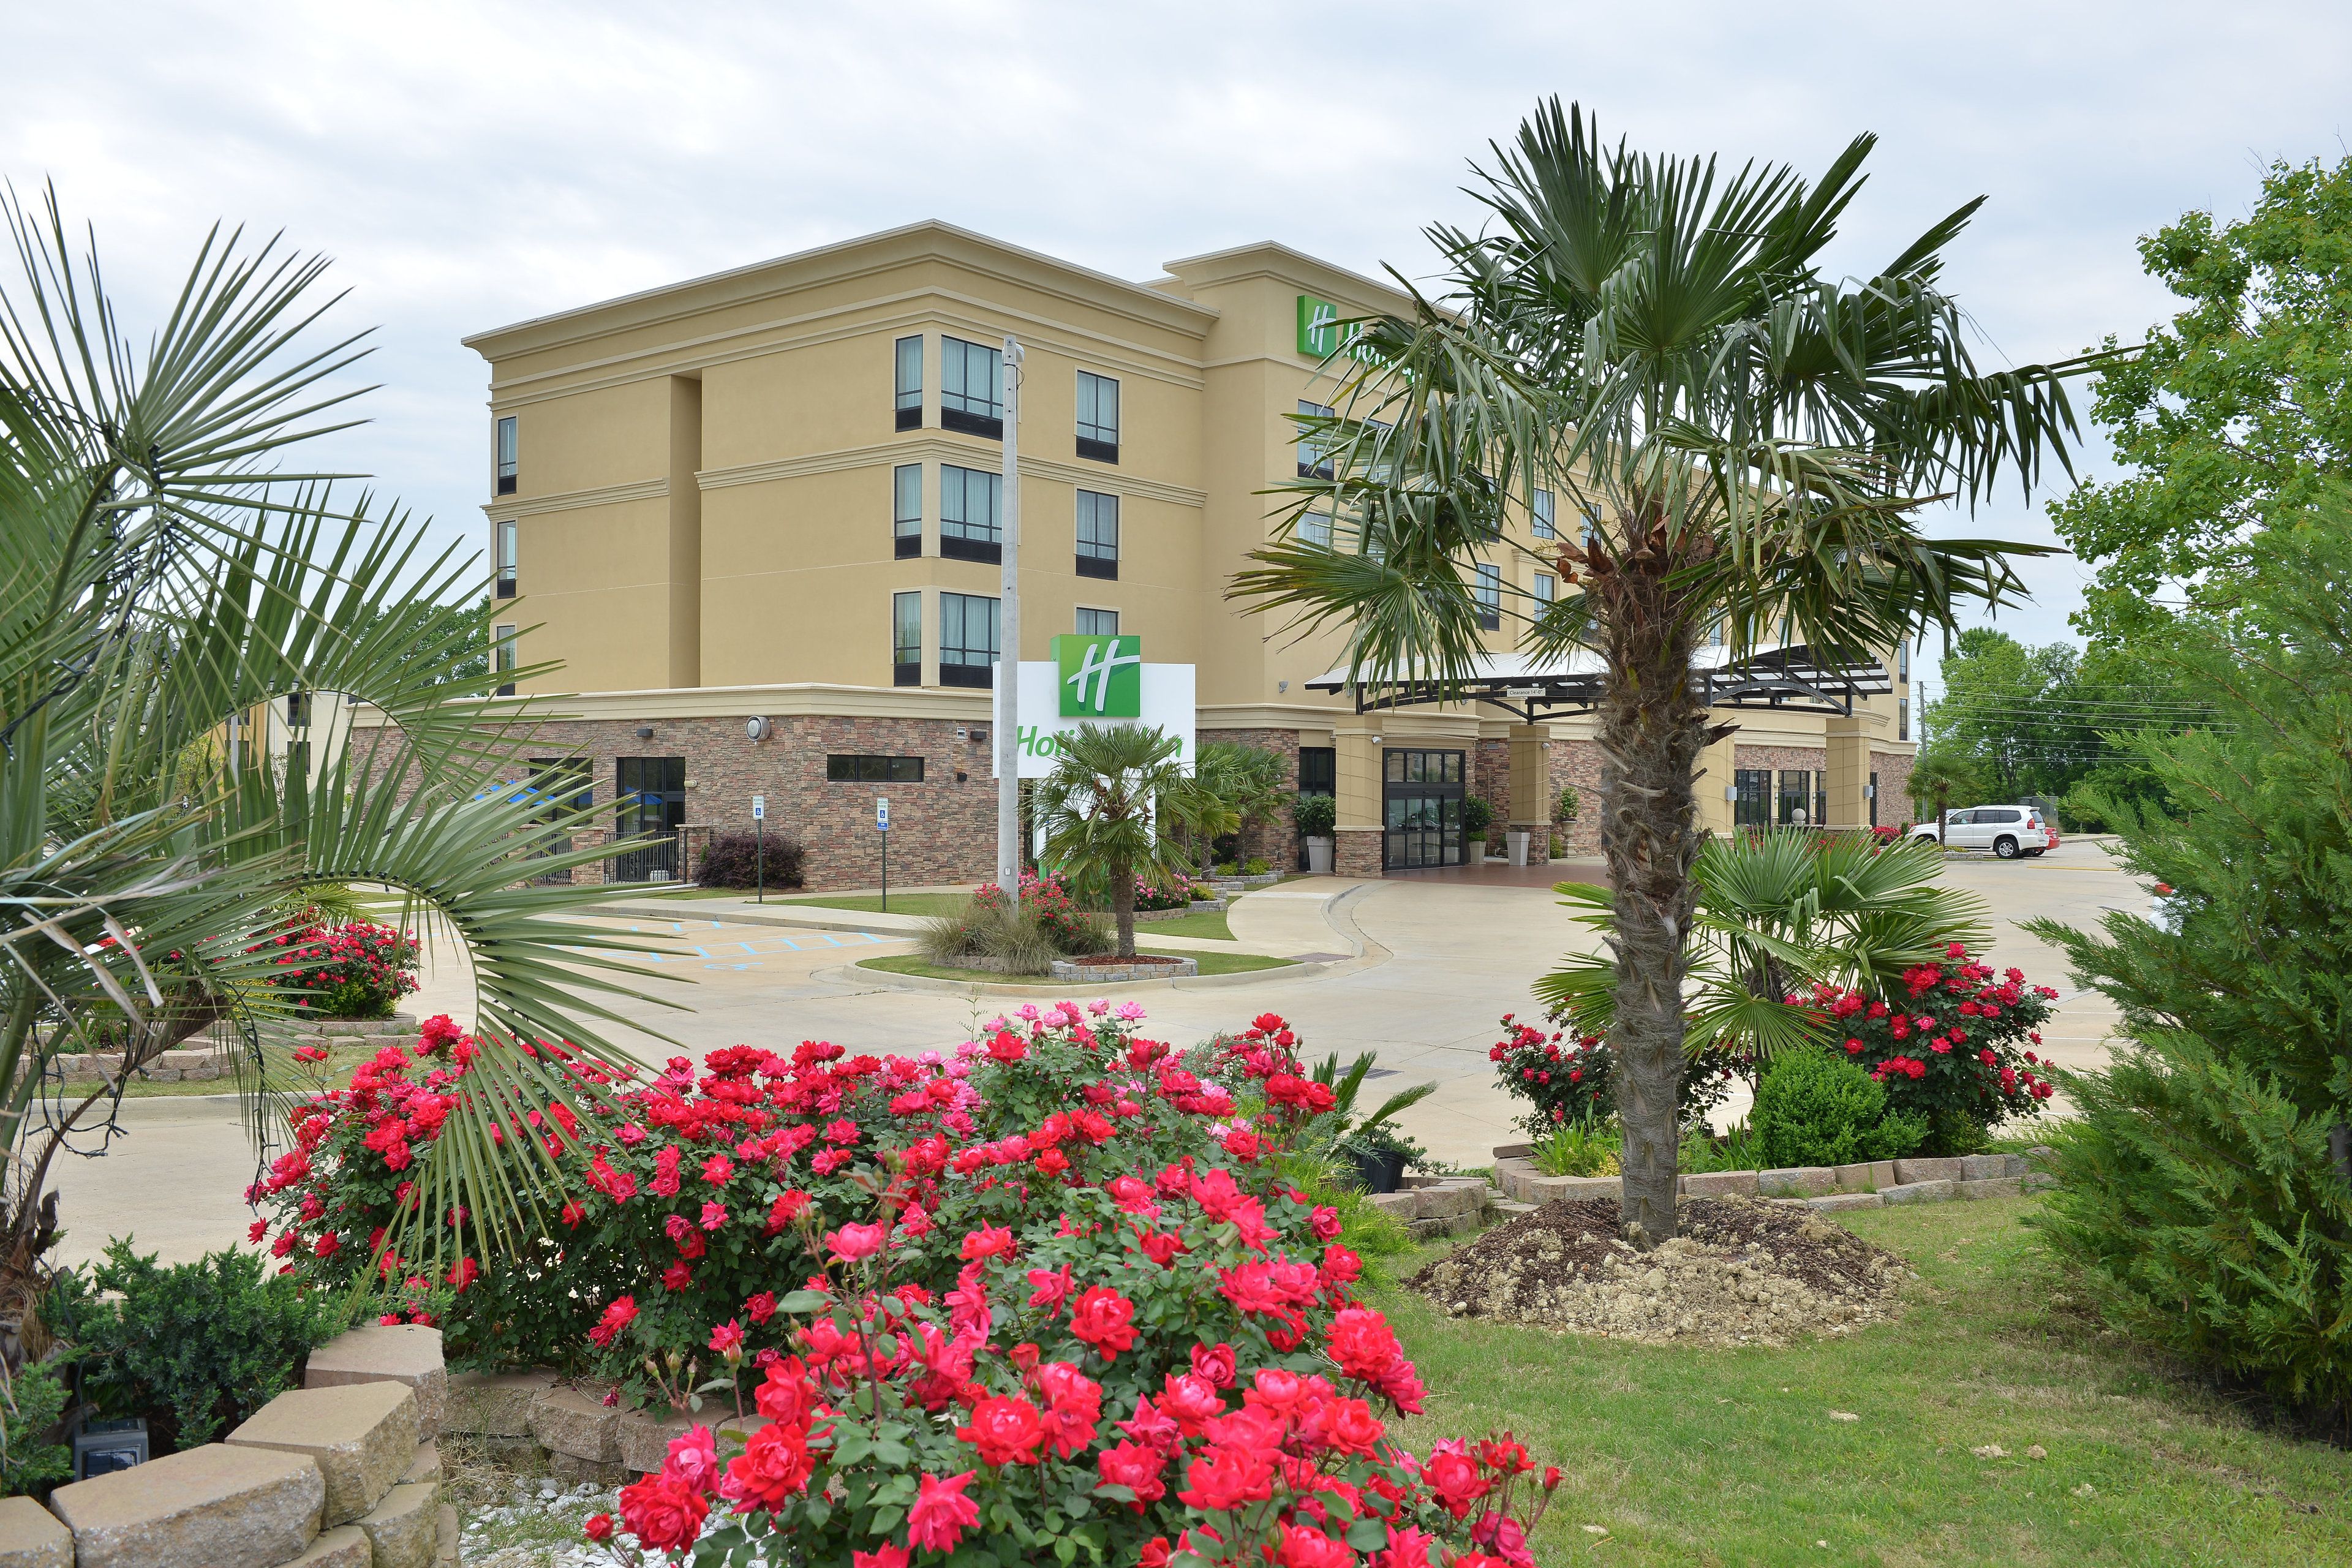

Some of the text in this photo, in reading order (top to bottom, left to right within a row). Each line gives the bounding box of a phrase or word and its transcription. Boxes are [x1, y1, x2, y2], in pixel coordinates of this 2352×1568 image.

[1307, 305, 1336, 353] H
[1066, 639, 1140, 712] H
[1017, 725, 1100, 760] Holi
